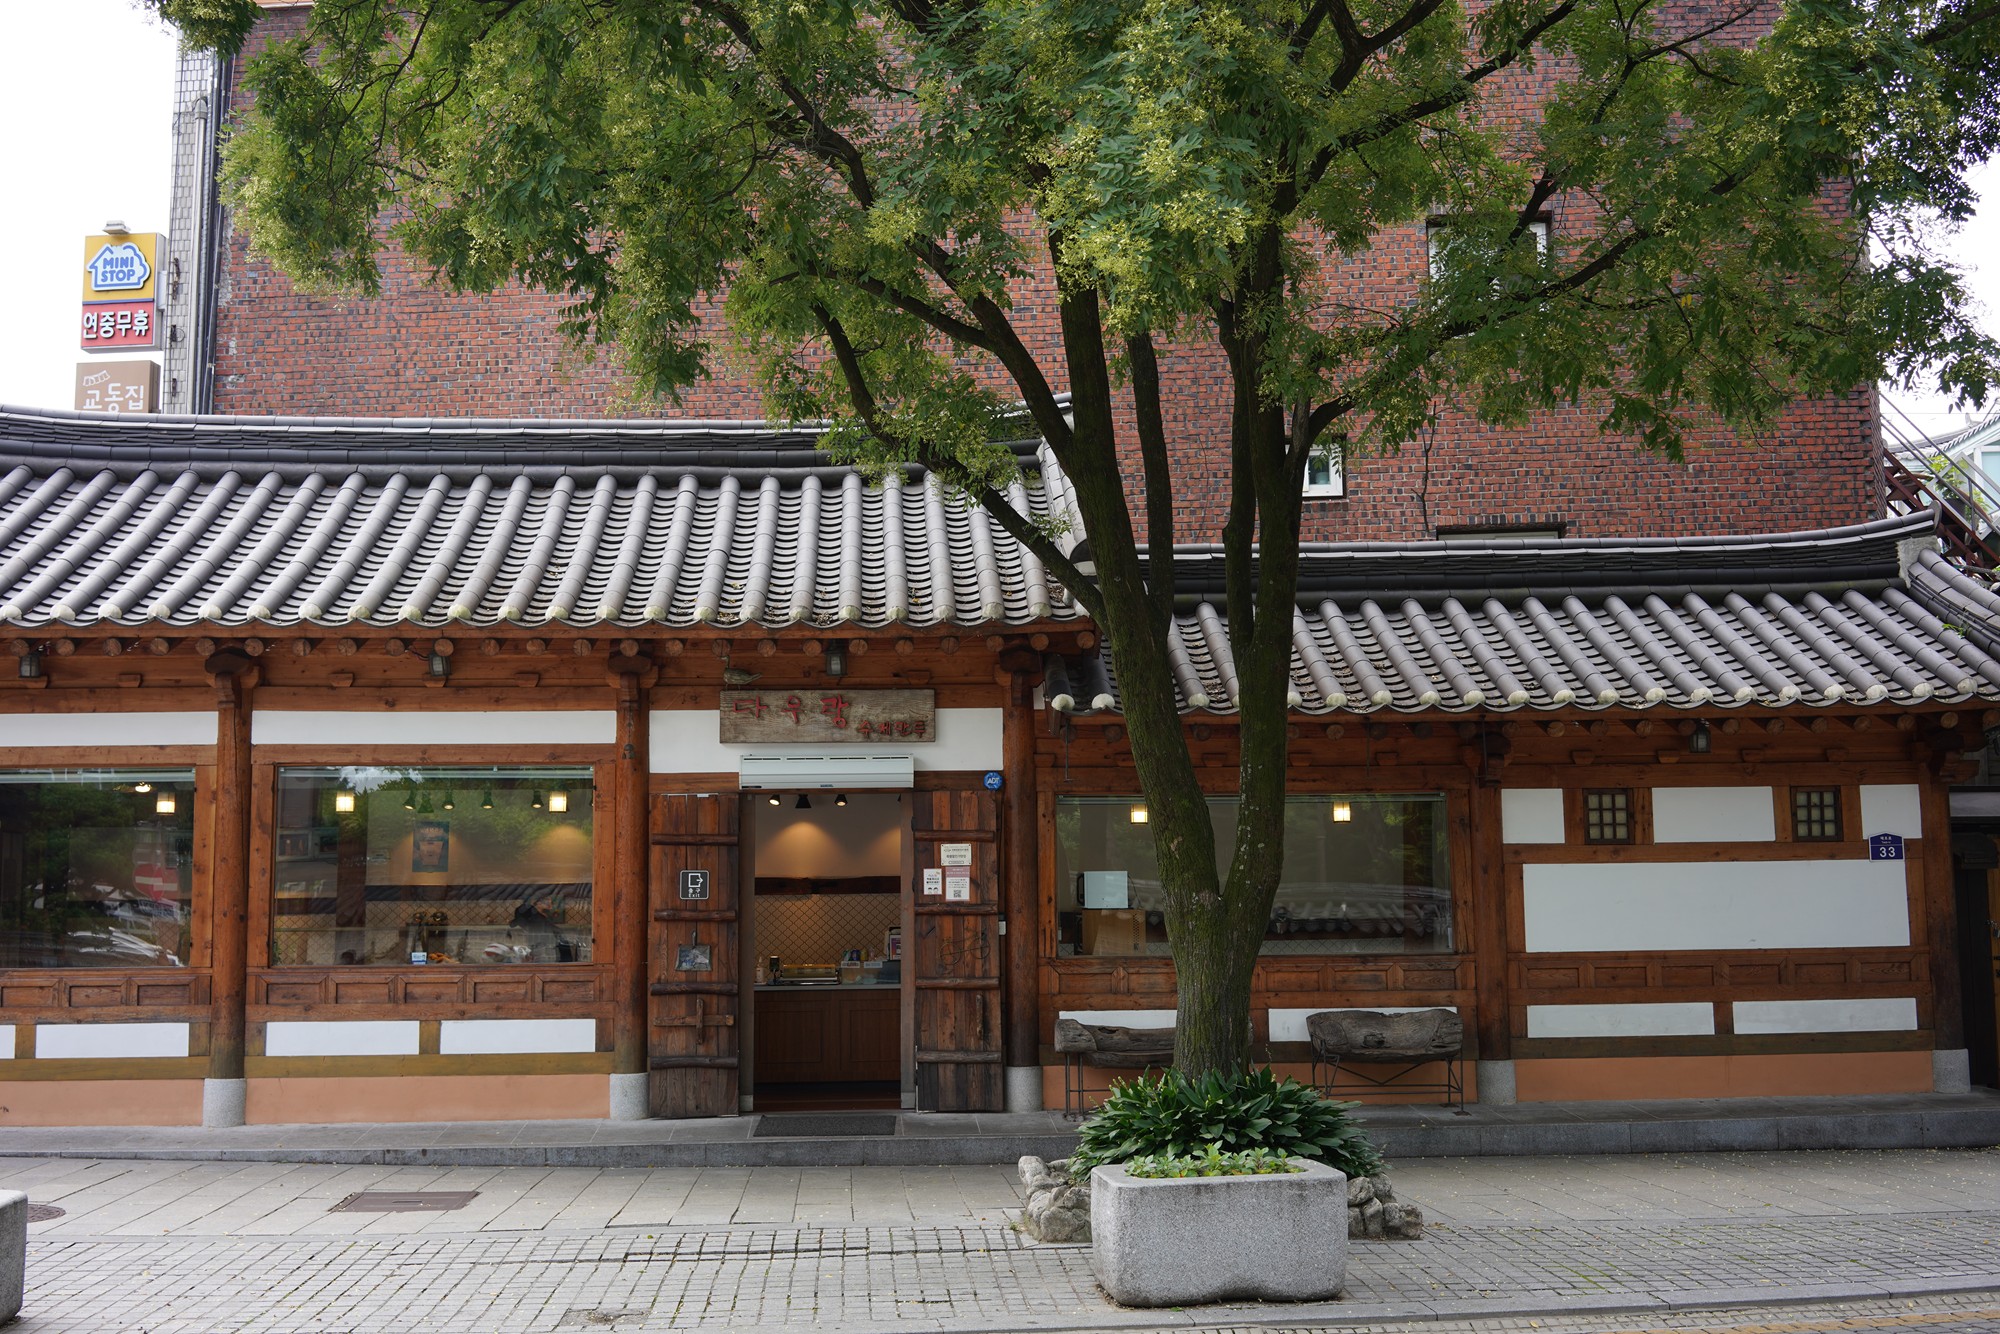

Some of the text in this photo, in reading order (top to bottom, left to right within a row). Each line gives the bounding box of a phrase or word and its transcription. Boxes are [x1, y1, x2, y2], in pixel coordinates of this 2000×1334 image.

[103, 257, 134, 269] MINI
[100, 268, 136, 282] STOP
[83, 309, 149, 339] 연중무휴
[83, 382, 144, 413] 교동집
[856, 719, 927, 739] 수제만두
[1880, 846, 1896, 858] 33
